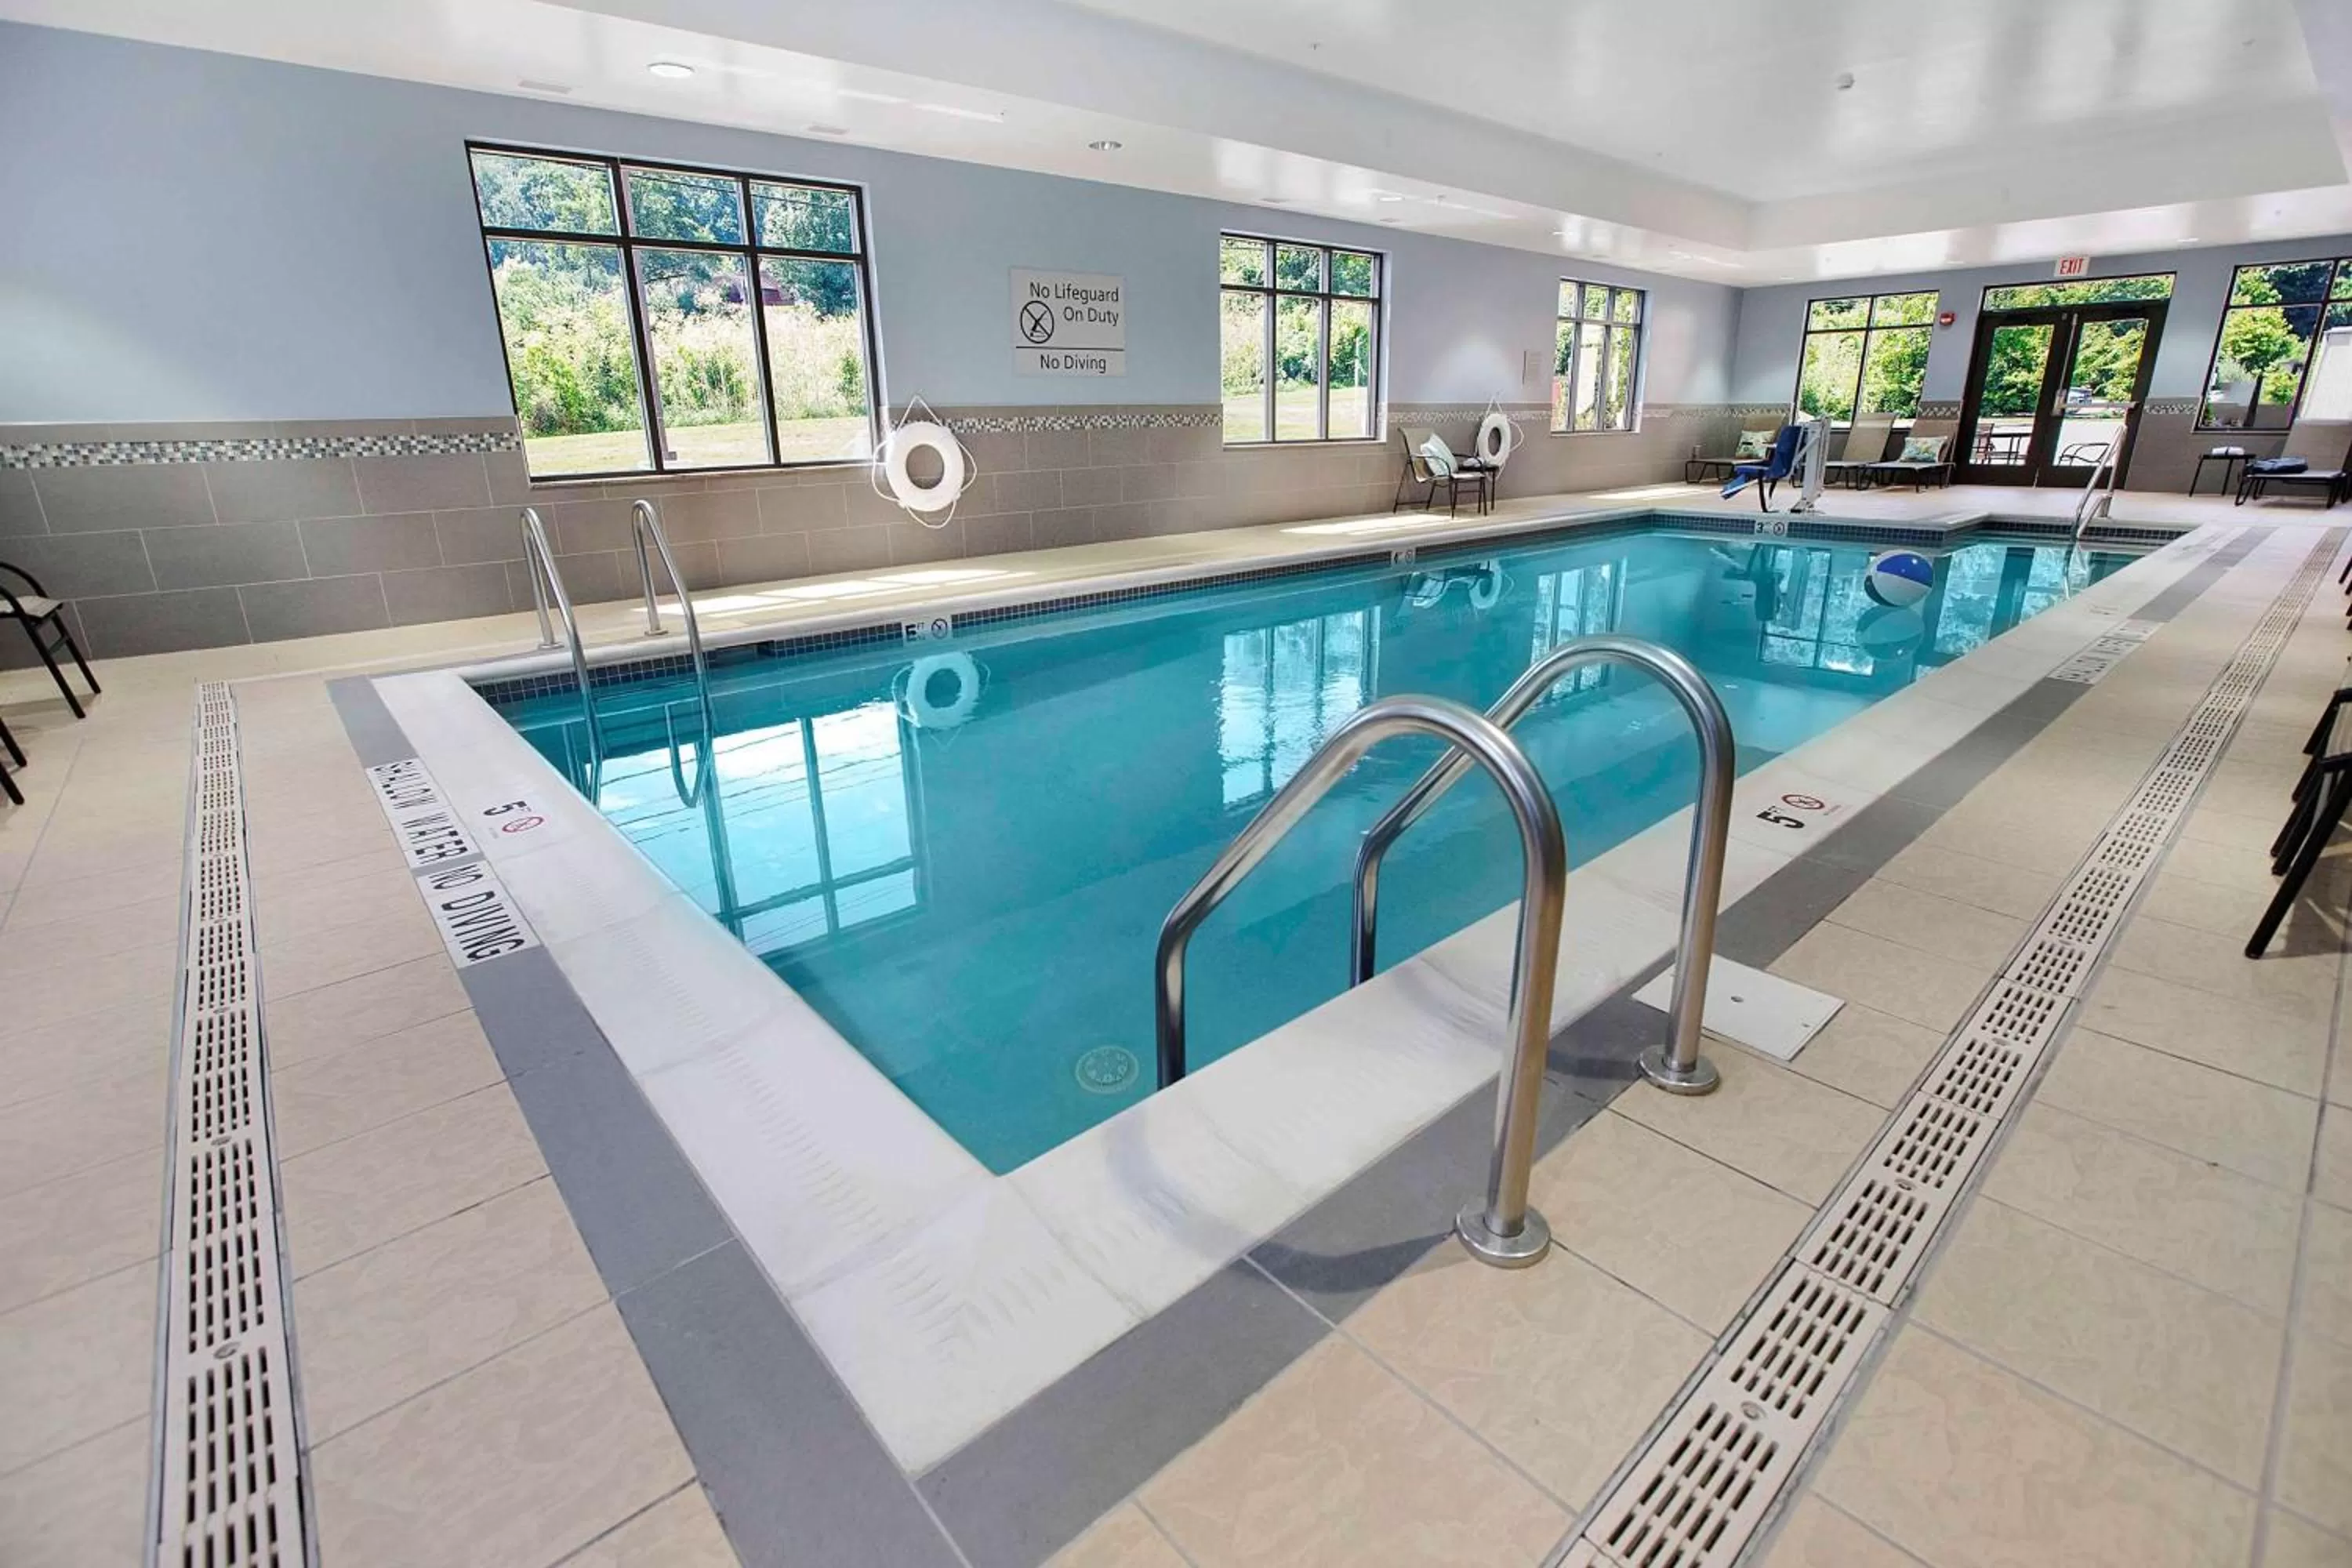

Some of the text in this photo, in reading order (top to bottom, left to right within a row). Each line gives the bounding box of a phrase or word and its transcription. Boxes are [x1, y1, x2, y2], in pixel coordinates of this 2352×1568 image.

[2060, 257, 2083, 274] EXIT
[1029, 281, 1120, 304] No Lifeguard
[1063, 307, 1119, 326] On Duty
[1040, 354, 1106, 373] No Diving
[483, 800, 527, 815] 5
[1756, 811, 1805, 828] 5
[401, 811, 468, 864] WATER
[428, 864, 524, 961] NO DIVING
